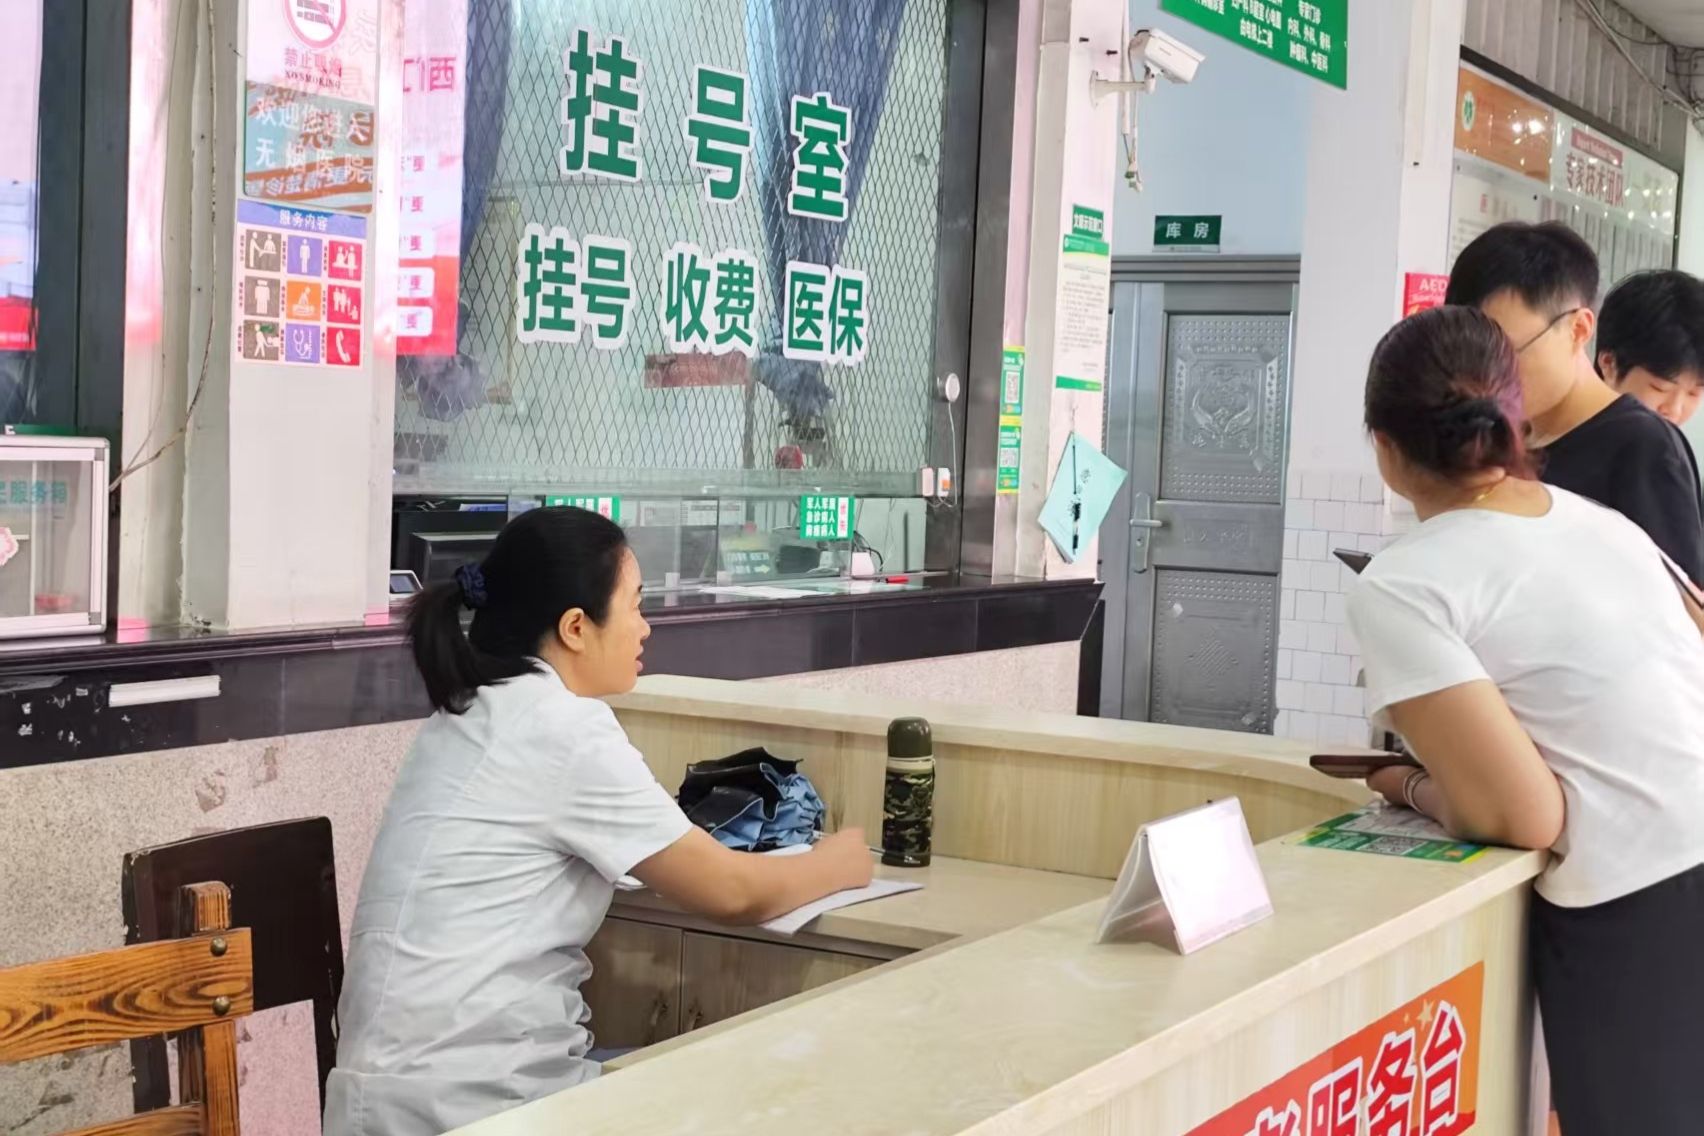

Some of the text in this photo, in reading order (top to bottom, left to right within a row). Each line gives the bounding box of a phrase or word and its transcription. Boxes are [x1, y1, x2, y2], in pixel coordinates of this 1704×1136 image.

[280, 208, 329, 231] 服务内容
[1165, 221, 1210, 239] 库房
[523, 234, 864, 356] 挂号 收费 医保
[1244, 1000, 1465, 1136] 服务台
